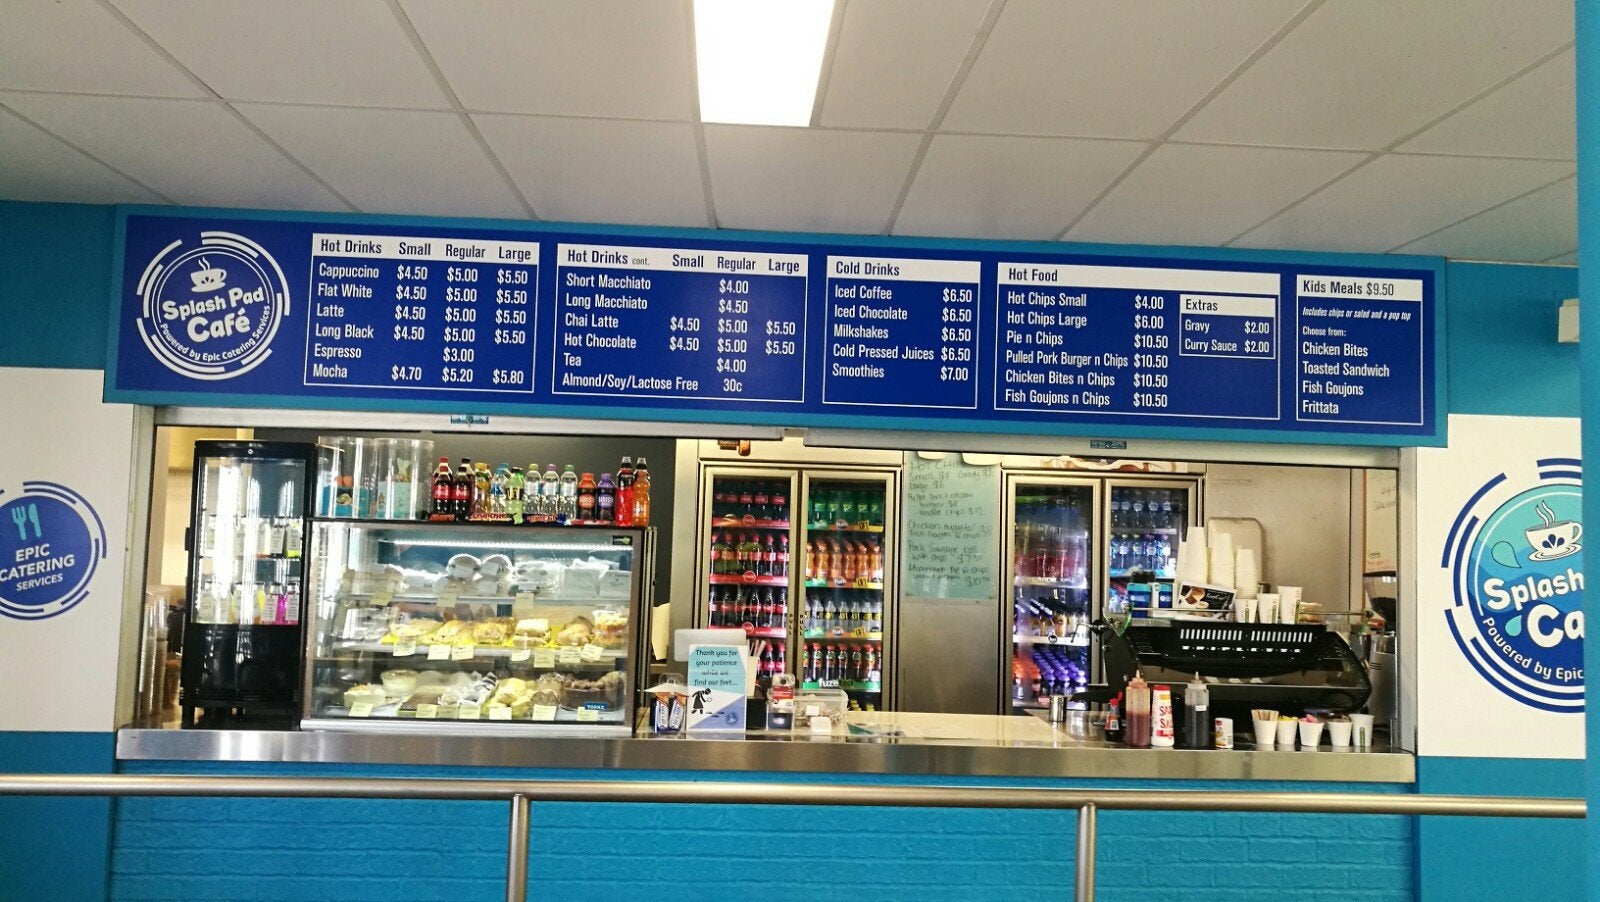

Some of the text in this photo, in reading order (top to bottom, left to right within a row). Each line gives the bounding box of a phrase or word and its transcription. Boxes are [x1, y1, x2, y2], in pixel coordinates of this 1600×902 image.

[321, 239, 530, 262] Hot Drinks Small Regular Large
[568, 250, 799, 274] Hot Drinks cont. Small Regular Large
[836, 262, 899, 276] Cold Drinks
[320, 263, 527, 284] Cappuccino $4.50 $5.00 $5.50
[1009, 268, 1057, 281] Hot Food
[567, 273, 748, 293] Short Macchiato $4.00
[1304, 280, 1393, 295] Kids Meals $9.50
[319, 283, 526, 304] Flat White $4.50 $5.00 $5.50
[835, 285, 972, 302] Iced Coffee $6.50
[1008, 291, 1163, 309] Hot Chips Small $4.00
[161, 286, 265, 322] Splash Pad
[566, 293, 748, 313] Long Macchiato $4.50
[1186, 299, 1217, 311] Extras
[317, 303, 526, 324] Latte $4.50 $5.00 $5.50
[835, 305, 971, 322] Iced Chocolate $6.50
[1008, 311, 1163, 329] Hot Chips Large $6.00
[1303, 307, 1327, 316] Includes
[1329, 309, 1344, 318] chips
[1354, 310, 1370, 318] salad
[1401, 312, 1411, 321] top
[160, 304, 270, 362] Powered by Epic Catering Services
[187, 311, 250, 342] Café
[566, 313, 795, 335] Chai Latte $4.50 $5.00 $5.50
[834, 324, 971, 341] Milkshakes $6.50
[1185, 319, 1269, 334] Gravy $2.00
[1303, 326, 1346, 336] Choose from:
[316, 323, 525, 344] Long Black $4.50 $5.00 $5.50
[1007, 330, 1168, 348] Pie n Chips $10.50
[315, 343, 474, 362] Espresso $3.00
[565, 333, 794, 354] Hot Chocolate $4.50 $5.00 $5.50
[834, 344, 970, 361] Cold Pressed Juices $6.50
[1185, 338, 1269, 353] Curry Sauce $2.00
[1303, 342, 1368, 356] Chicken Bites
[564, 353, 746, 372] Tea $4.00
[1007, 350, 1168, 368] Pulled Pork Burger n Chips $10.50
[313, 364, 523, 384] Mocha $4.70 $5.20 $5.80
[833, 363, 968, 381] Smoothies $7.00
[1303, 361, 1389, 376] Toasted Sandwich
[563, 373, 742, 392] Almond/Soy/Lactose Free 30c
[1006, 370, 1167, 388] Chicken Bites n Chips $10.50
[1303, 380, 1363, 397] Fish Goujons
[1006, 389, 1167, 407] Fish Goujons n Chips $10.50
[1303, 400, 1338, 413] Frittata
[15, 544, 50, 562] EPIC
[16, 573, 63, 592] SERVICES
[1483, 568, 1584, 611] Splash
[1482, 617, 1584, 682] Powered by Epic
